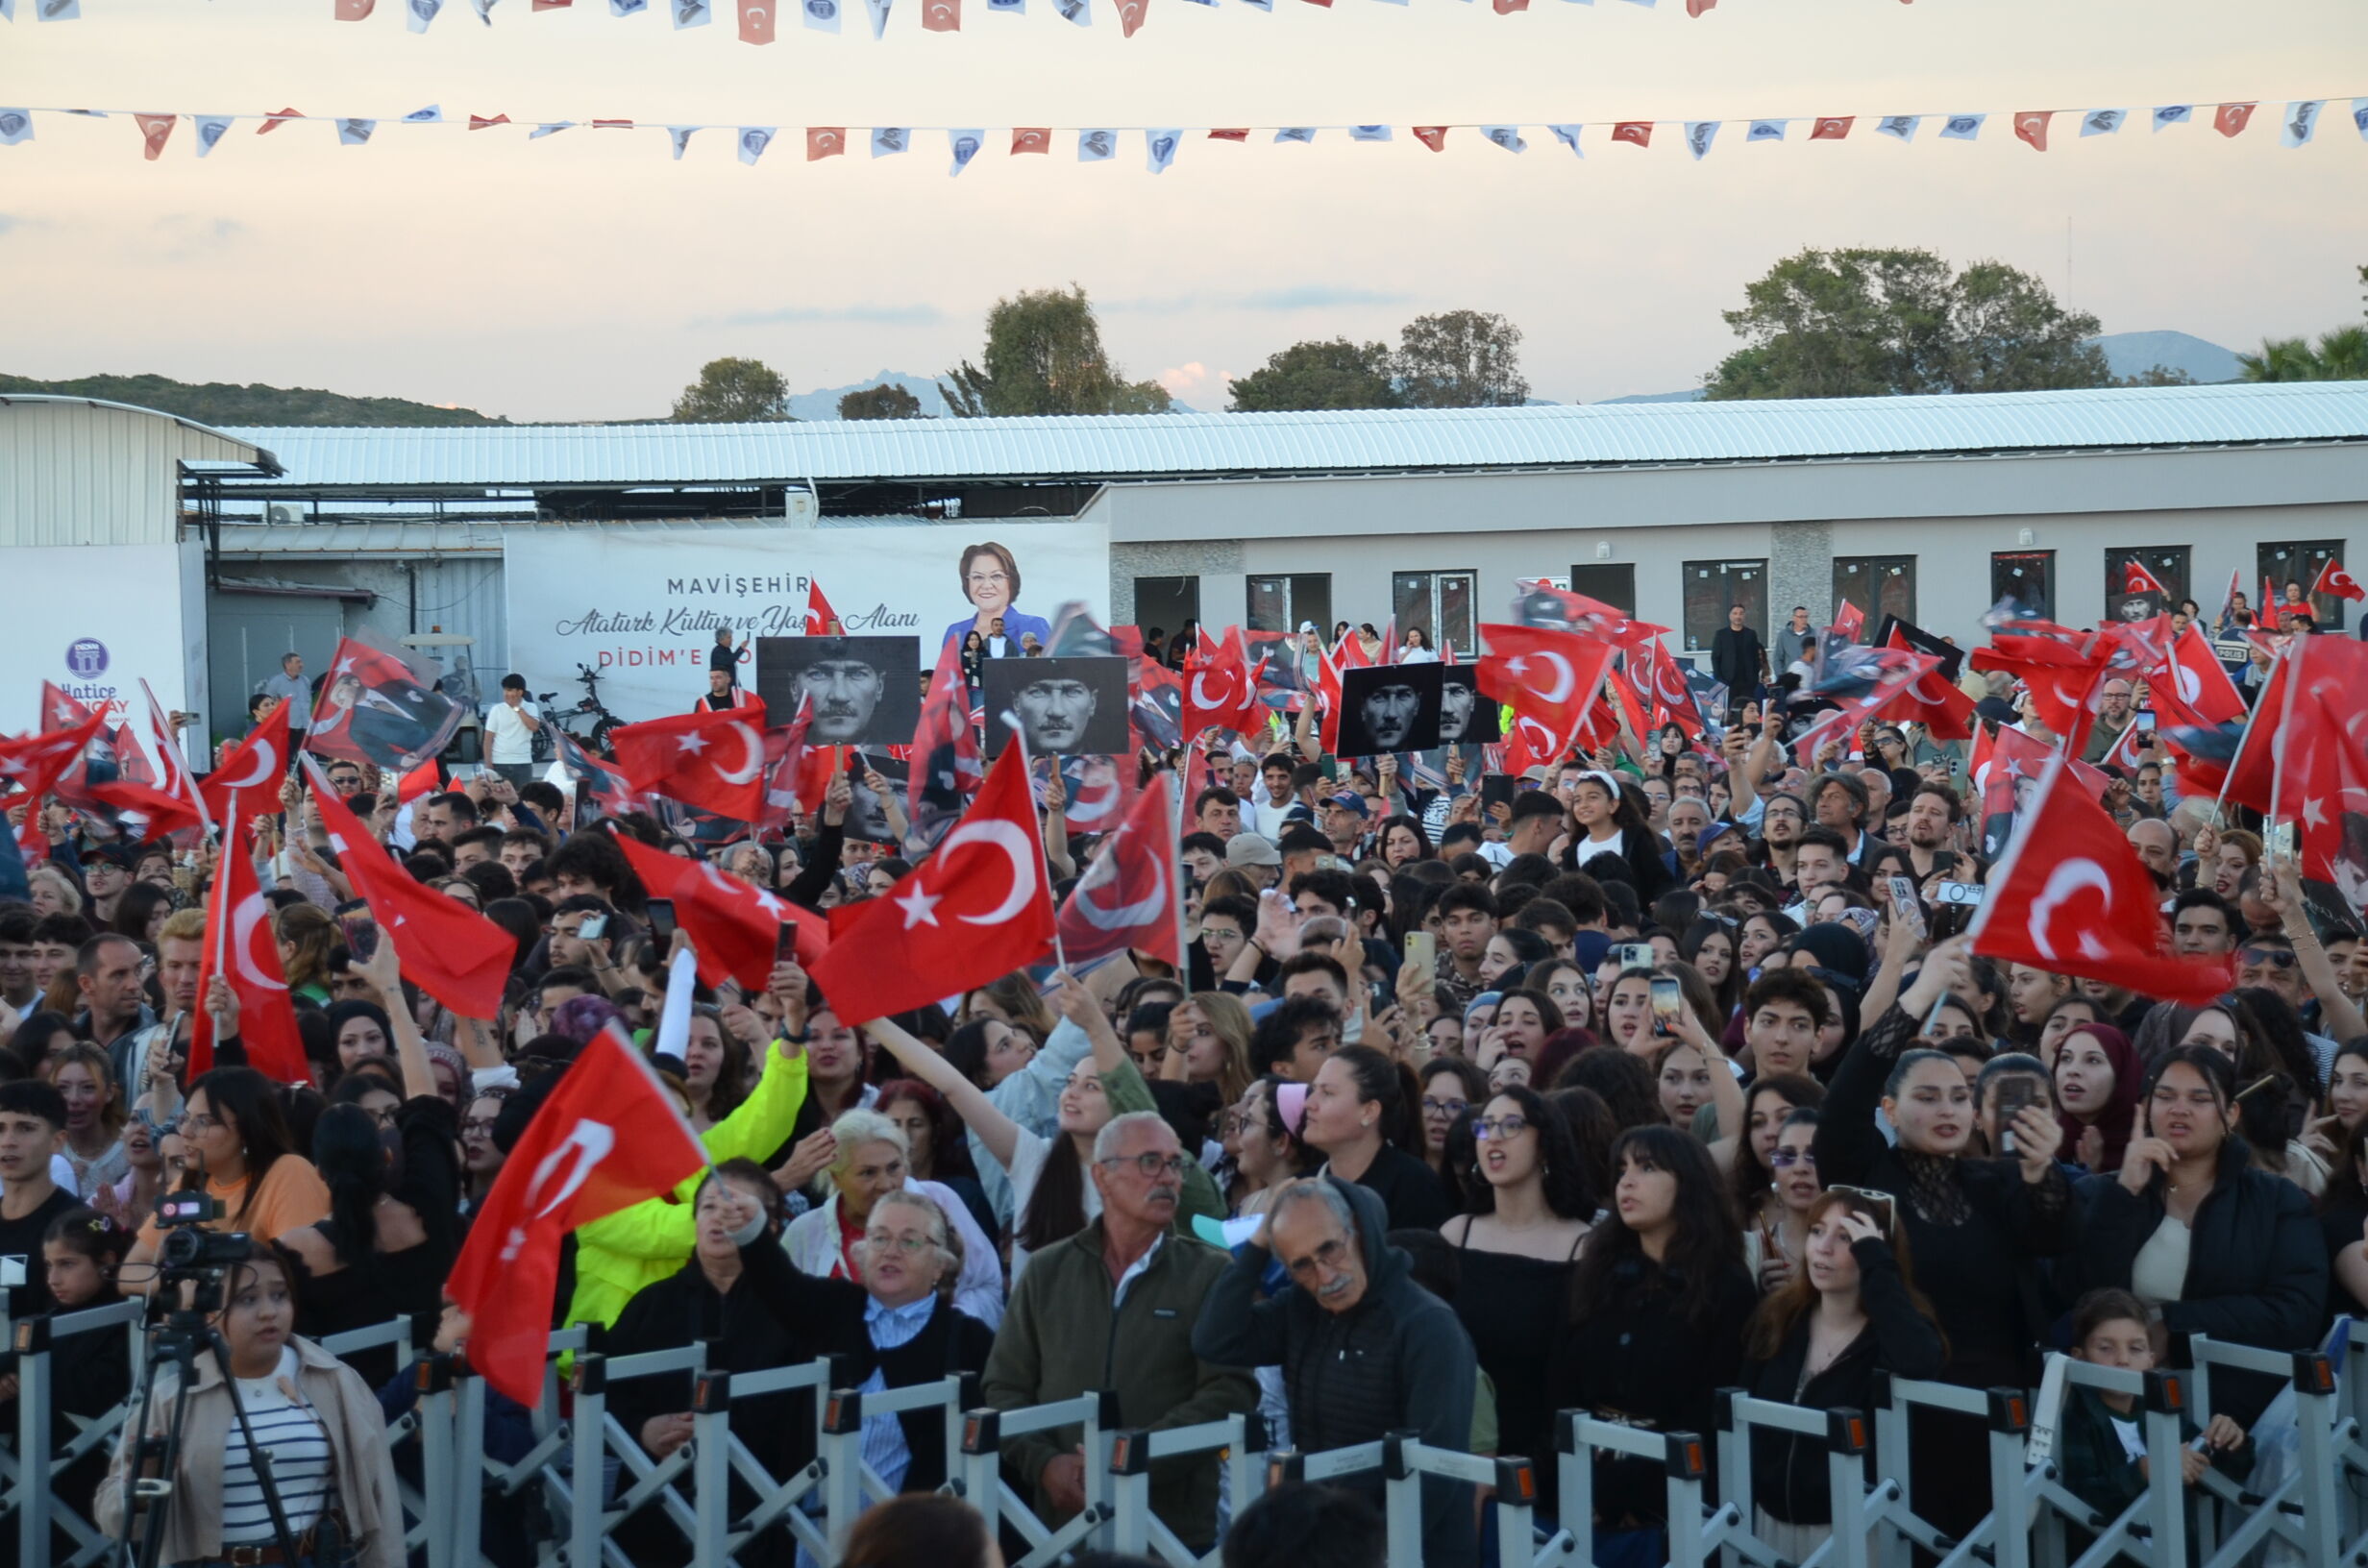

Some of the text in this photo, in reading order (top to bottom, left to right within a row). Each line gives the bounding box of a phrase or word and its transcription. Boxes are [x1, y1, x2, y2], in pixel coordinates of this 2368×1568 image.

[667, 573, 809, 598] MAVİŞEHİR
[555, 608, 657, 636] Atatürk
[659, 606, 734, 636] Kültür
[735, 615, 759, 630] ve
[845, 603, 920, 630] Alanı
[598, 647, 703, 667] DİDİM'E
[62, 683, 117, 698] Hatice
